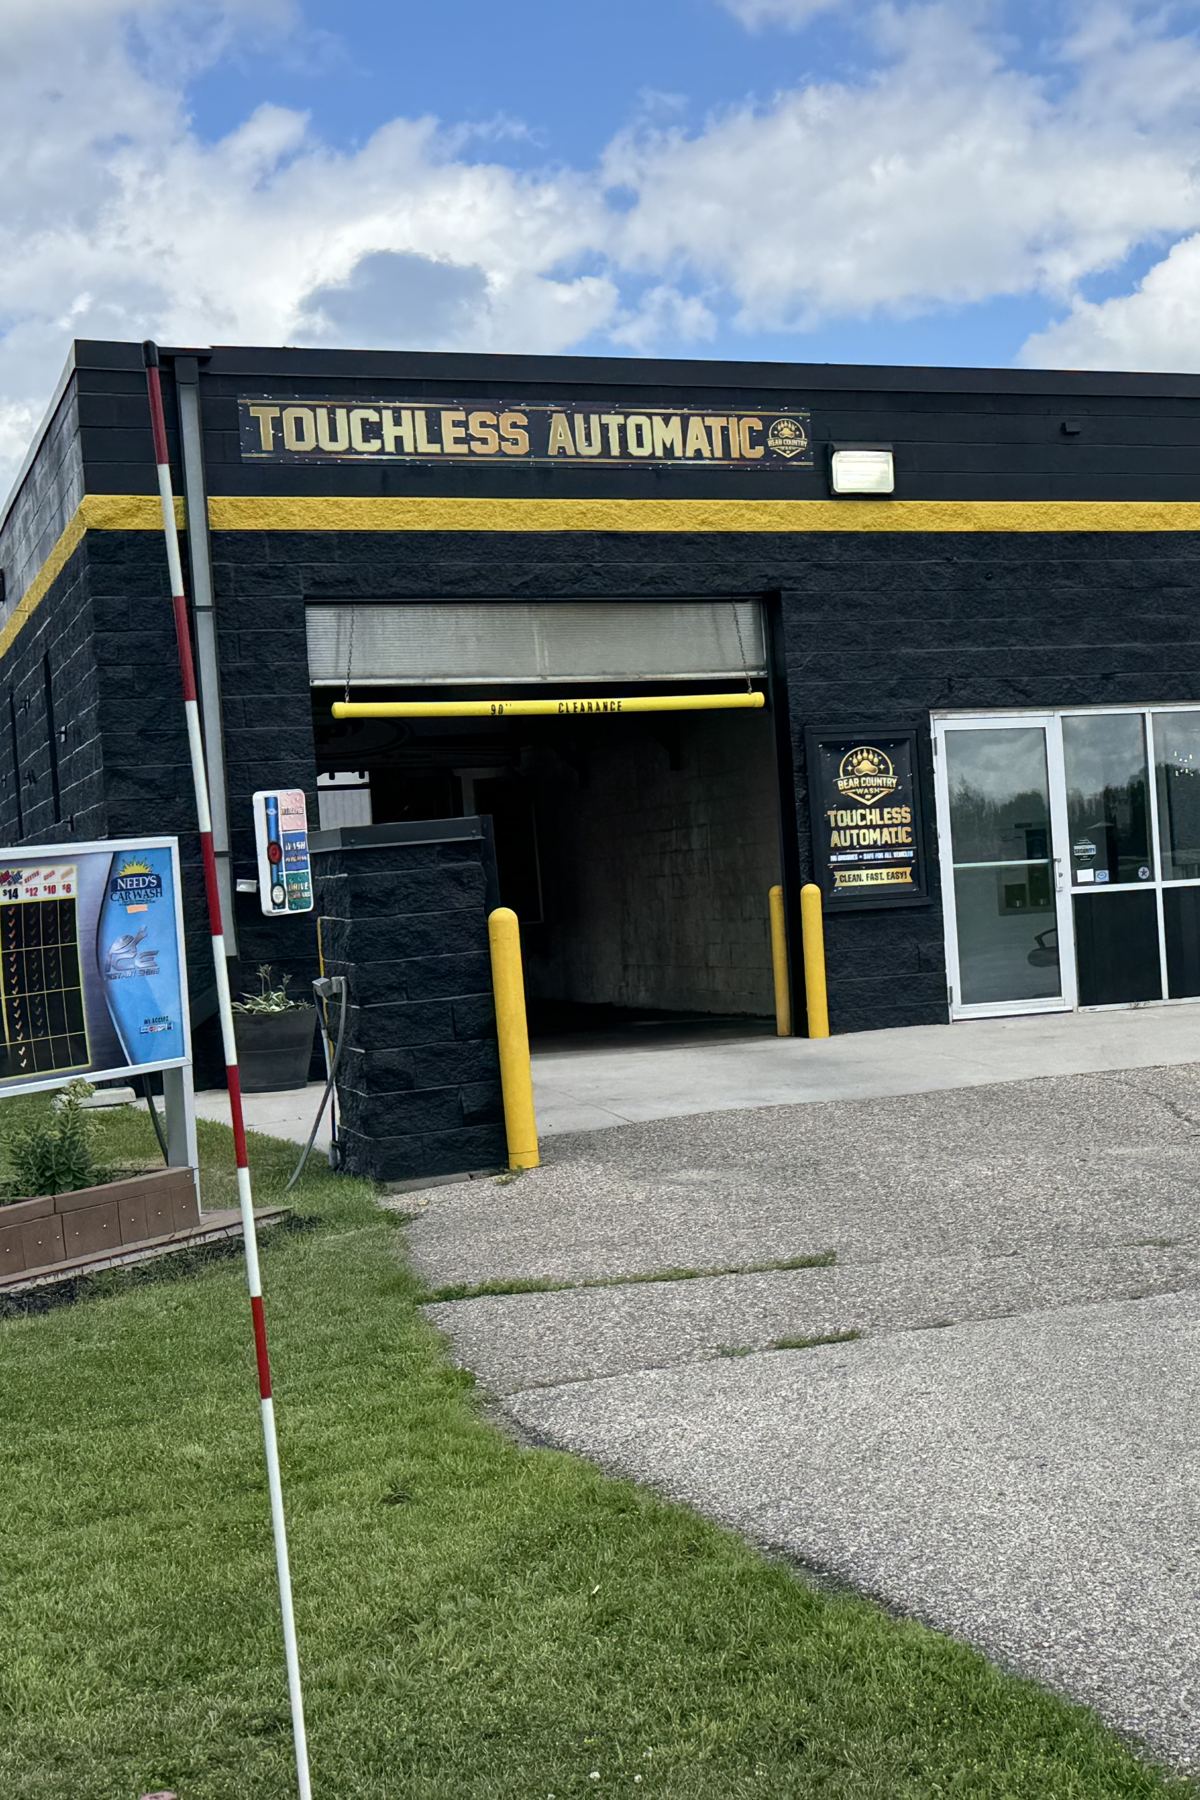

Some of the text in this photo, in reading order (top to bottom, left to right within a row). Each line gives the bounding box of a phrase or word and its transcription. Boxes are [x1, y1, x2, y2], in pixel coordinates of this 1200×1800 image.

[249, 406, 765, 459] TOUCHLESS AUTOMATIC
[558, 700, 622, 714] CLEARANCE
[838, 776, 898, 790] BEAR COUNTRY
[856, 787, 881, 795] WASH
[828, 807, 912, 828] TOUCHLESS
[830, 827, 912, 848] AUTOMATIC
[117, 875, 158, 890] NEED'S
[839, 871, 908, 883] CLEAN. FAST. EASY!
[3, 888, 19, 900] $14
[25, 887, 39, 897] $12
